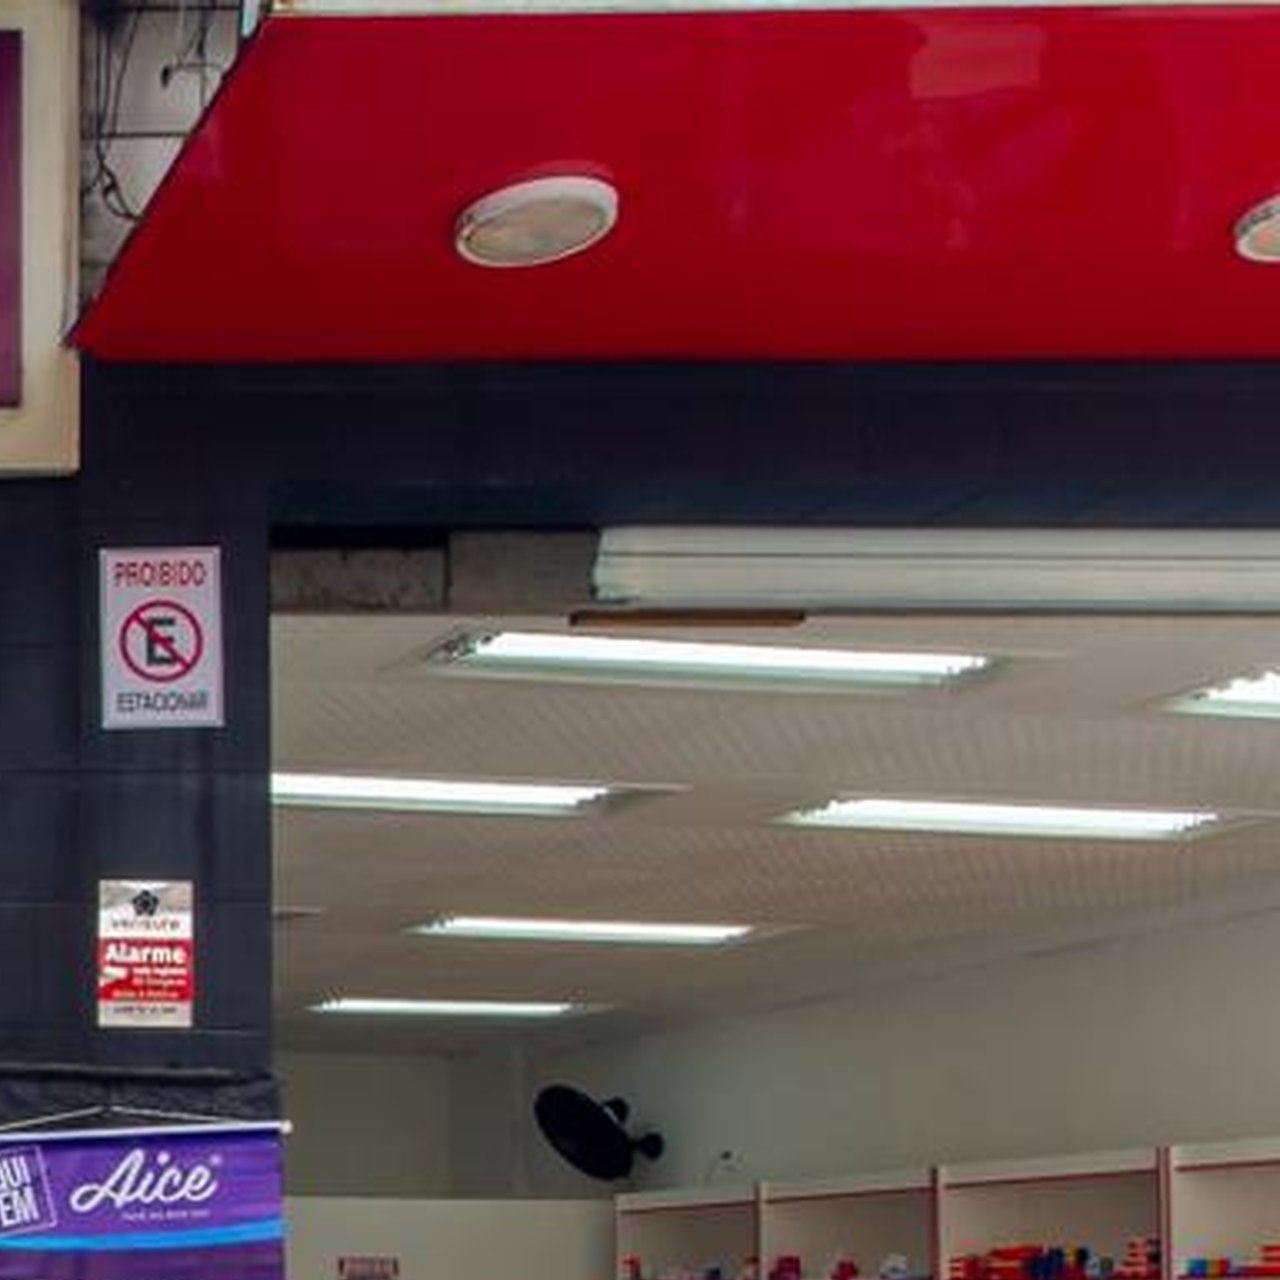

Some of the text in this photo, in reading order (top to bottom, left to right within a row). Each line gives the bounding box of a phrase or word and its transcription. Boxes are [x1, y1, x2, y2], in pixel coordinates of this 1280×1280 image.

[114, 561, 207, 587] PROIBIDO
[116, 692, 208, 712] ESTACIONAR
[106, 943, 188, 963] Alarme
[70, 1149, 218, 1212] Aice
